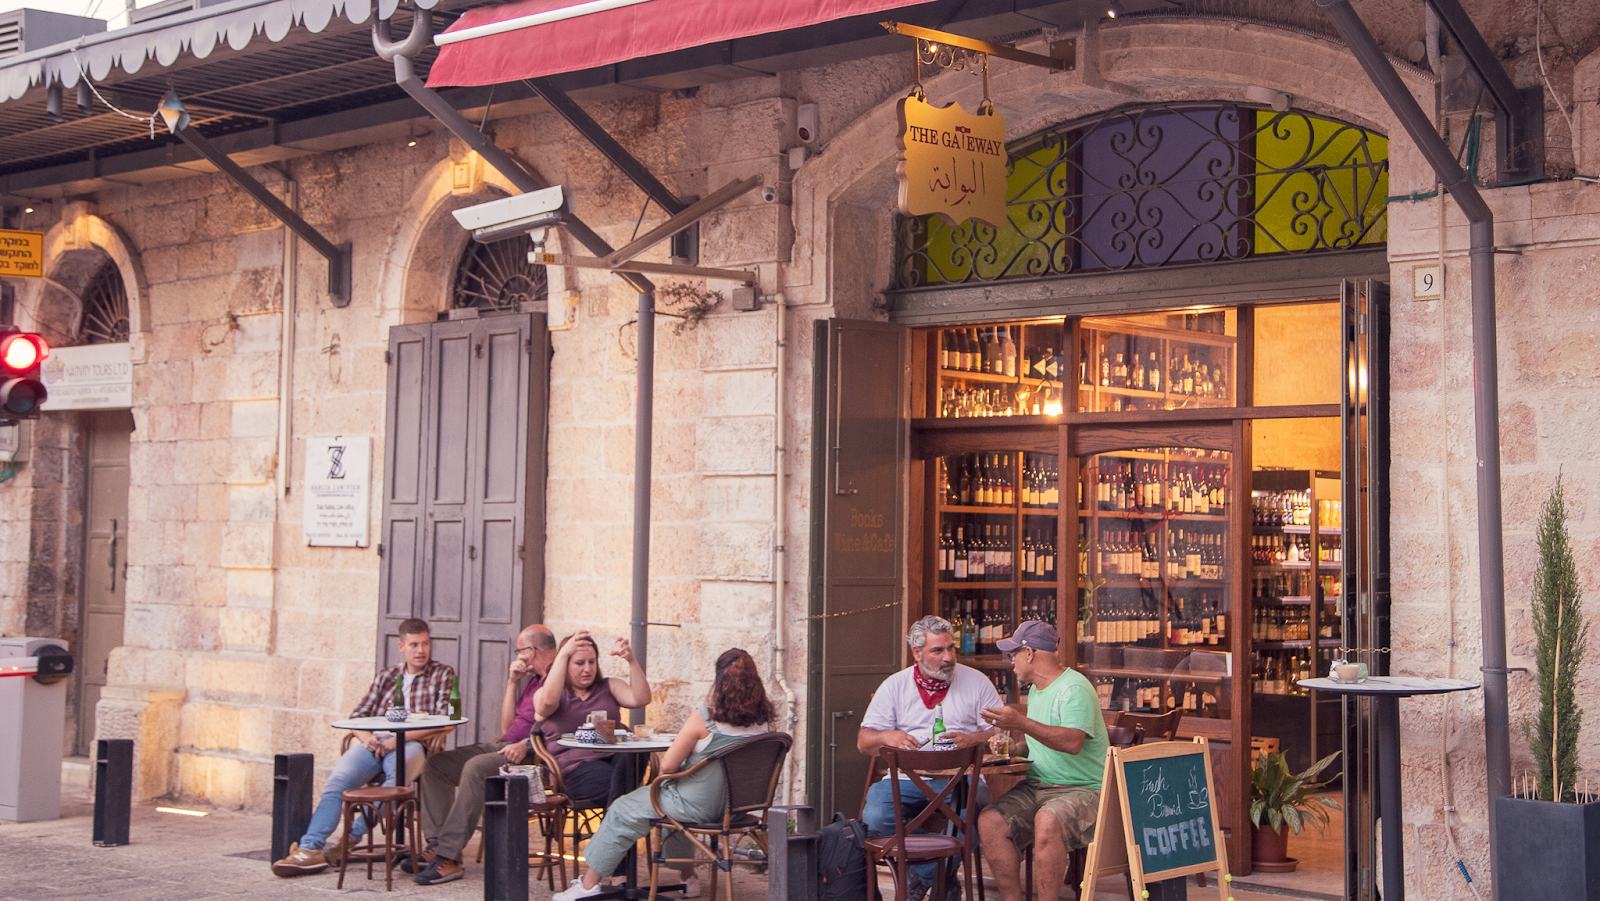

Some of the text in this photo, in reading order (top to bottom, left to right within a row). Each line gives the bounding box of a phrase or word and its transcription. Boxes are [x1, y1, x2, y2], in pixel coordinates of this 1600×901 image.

[909, 125, 1002, 156] THE GATEWAY
[0, 237, 29, 247] במקר
[13, 260, 39, 271] למוקד
[1423, 273, 1433, 292] 9
[1088, 462, 1231, 488] THE GATEWAY
[850, 507, 884, 528] Books
[1140, 764, 1170, 796] Fresh
[1143, 816, 1211, 856] COFFEE
